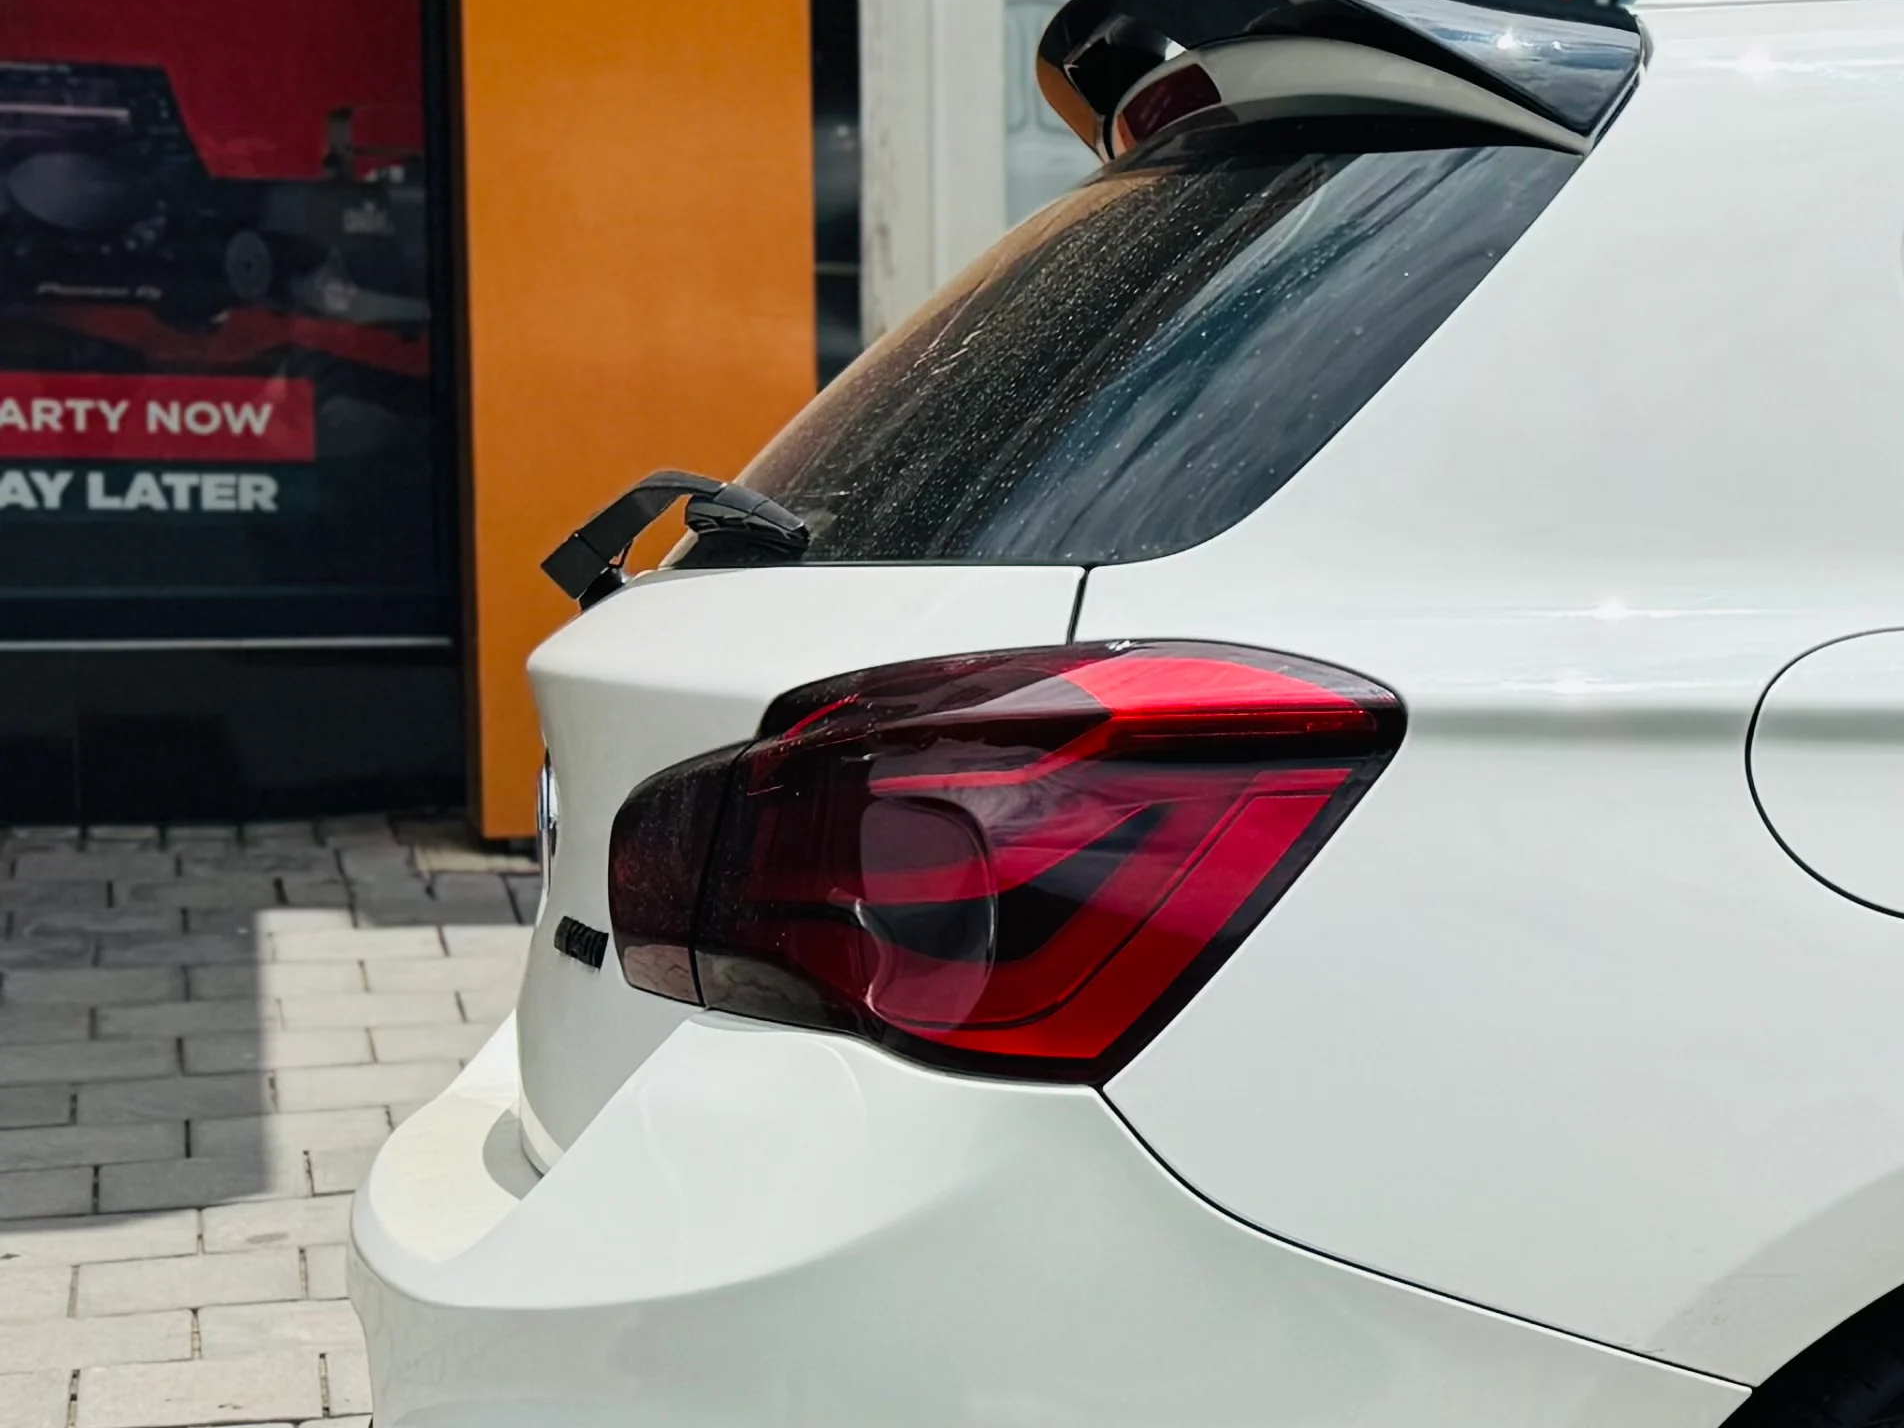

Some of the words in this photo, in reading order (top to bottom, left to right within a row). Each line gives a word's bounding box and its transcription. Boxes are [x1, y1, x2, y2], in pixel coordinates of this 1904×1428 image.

[0, 398, 129, 433] ARTY
[147, 400, 273, 436] NOW
[0, 470, 74, 509] AY
[87, 472, 278, 511] LATER
